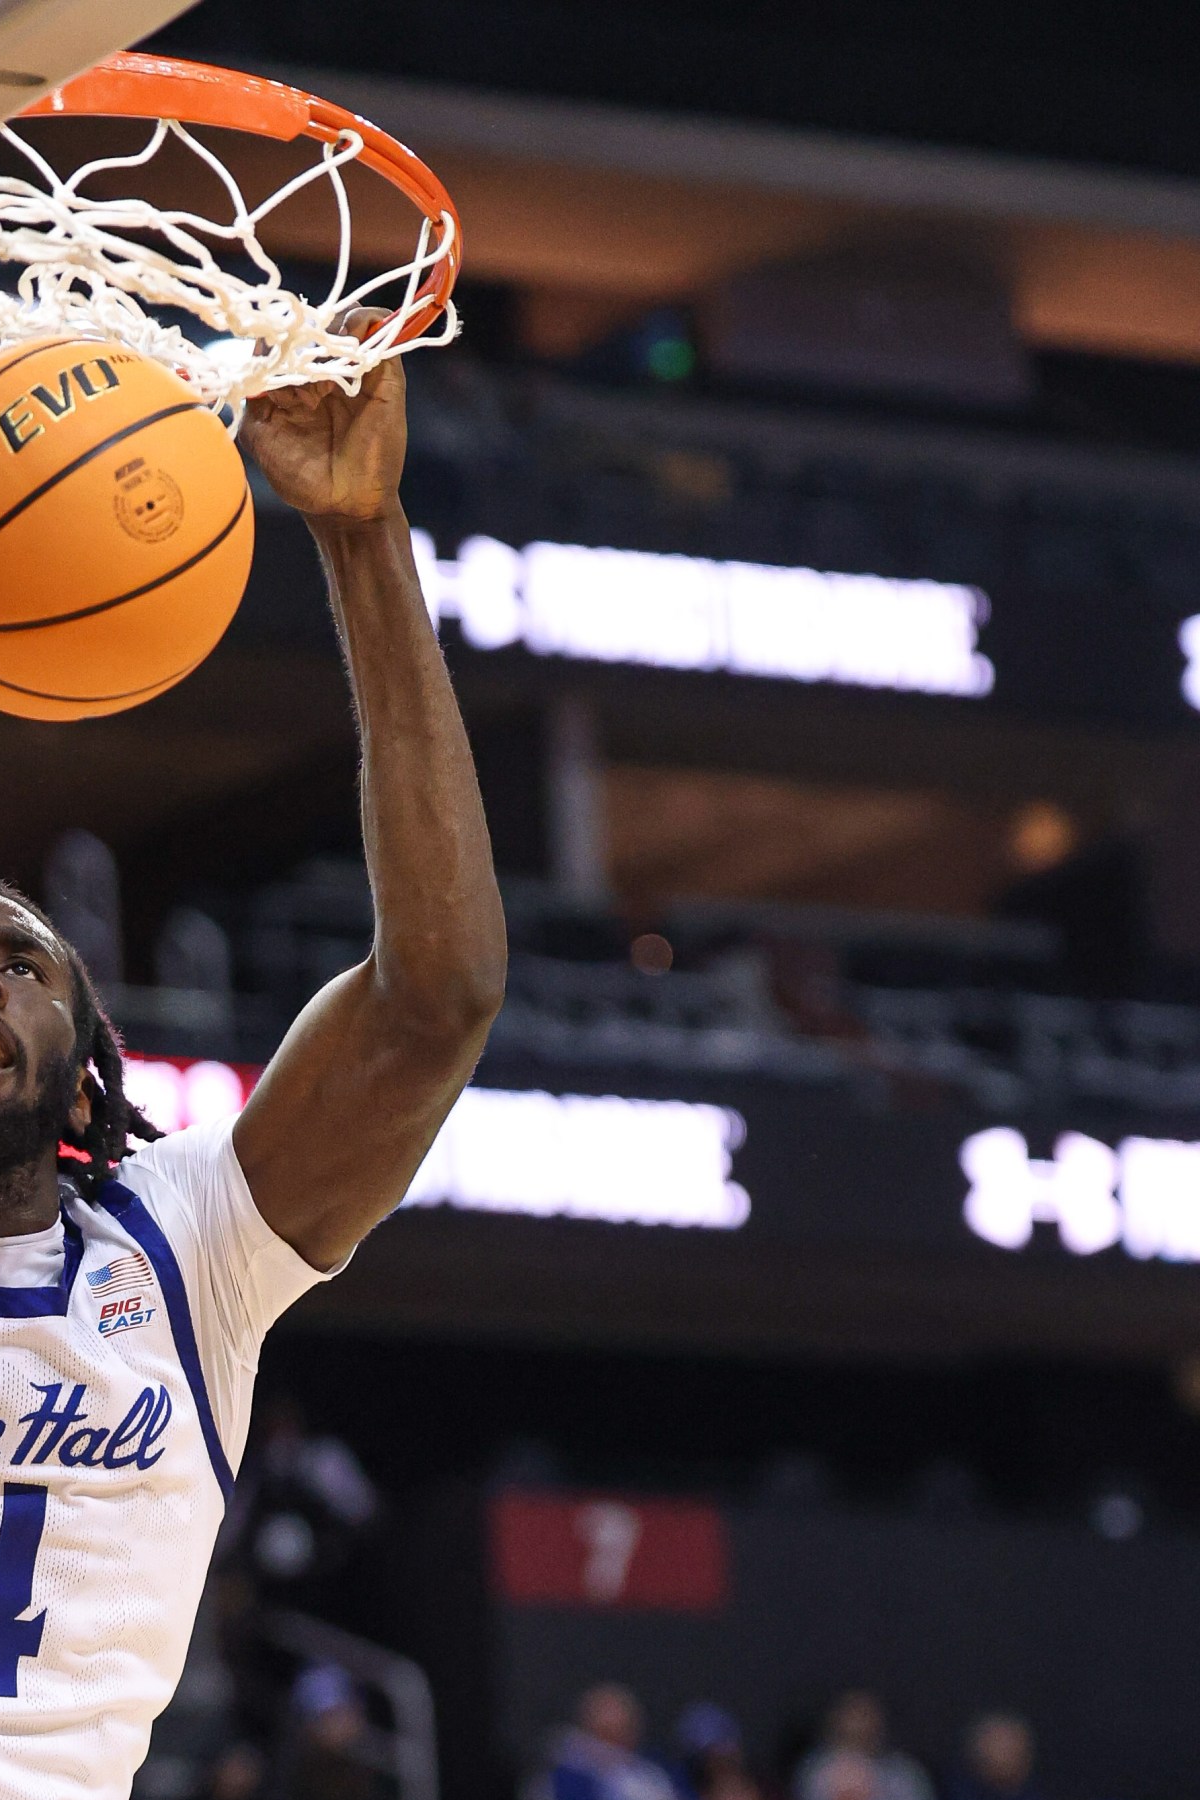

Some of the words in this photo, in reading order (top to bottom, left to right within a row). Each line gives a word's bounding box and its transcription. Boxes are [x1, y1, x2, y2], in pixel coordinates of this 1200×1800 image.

[98, 1308, 157, 1334] EAST
[100, 1296, 142, 1320] BIG
[9, 1382, 172, 1470] Hall
